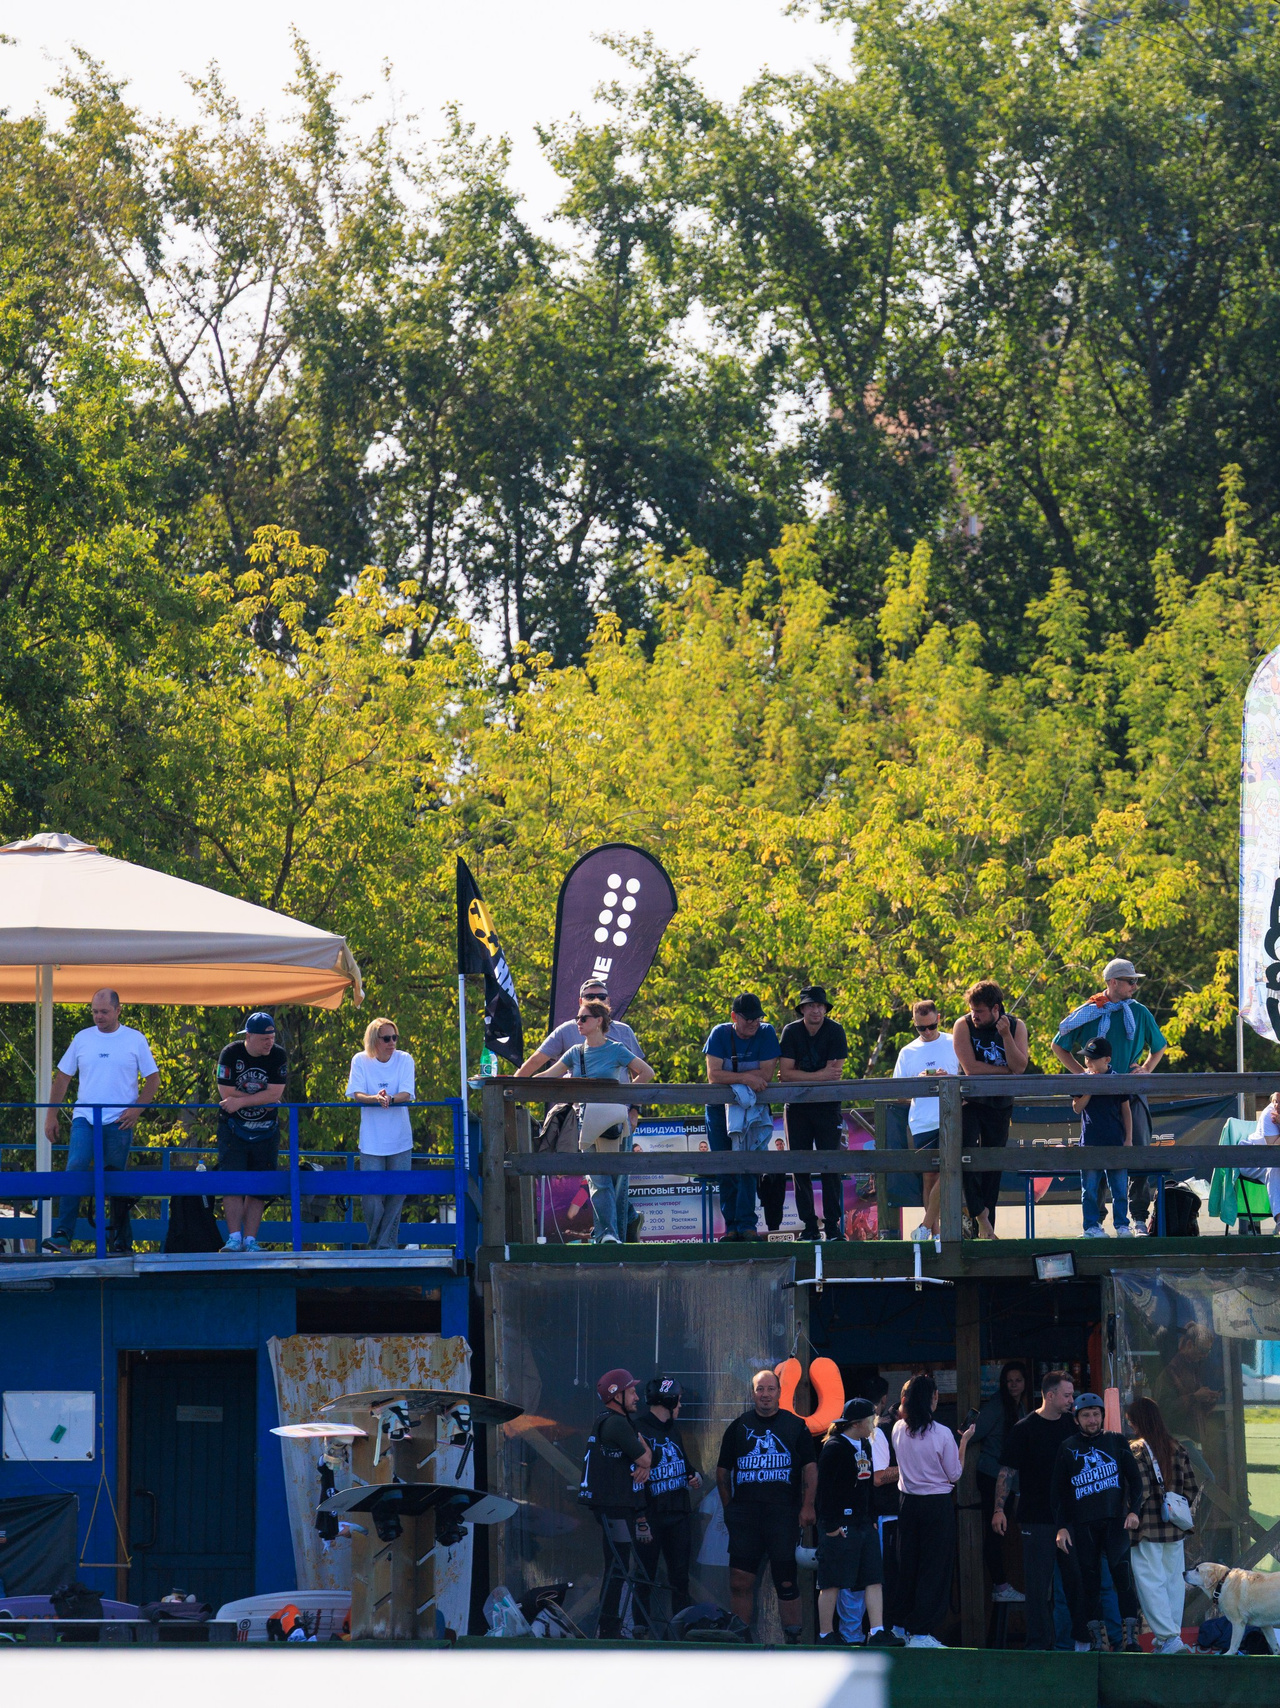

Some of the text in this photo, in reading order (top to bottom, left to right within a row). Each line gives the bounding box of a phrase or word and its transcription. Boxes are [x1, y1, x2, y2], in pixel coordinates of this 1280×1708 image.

[737, 1468, 792, 1484] OPEN CONTEST
[1075, 1474, 1120, 1500] OPEN CONTEST
